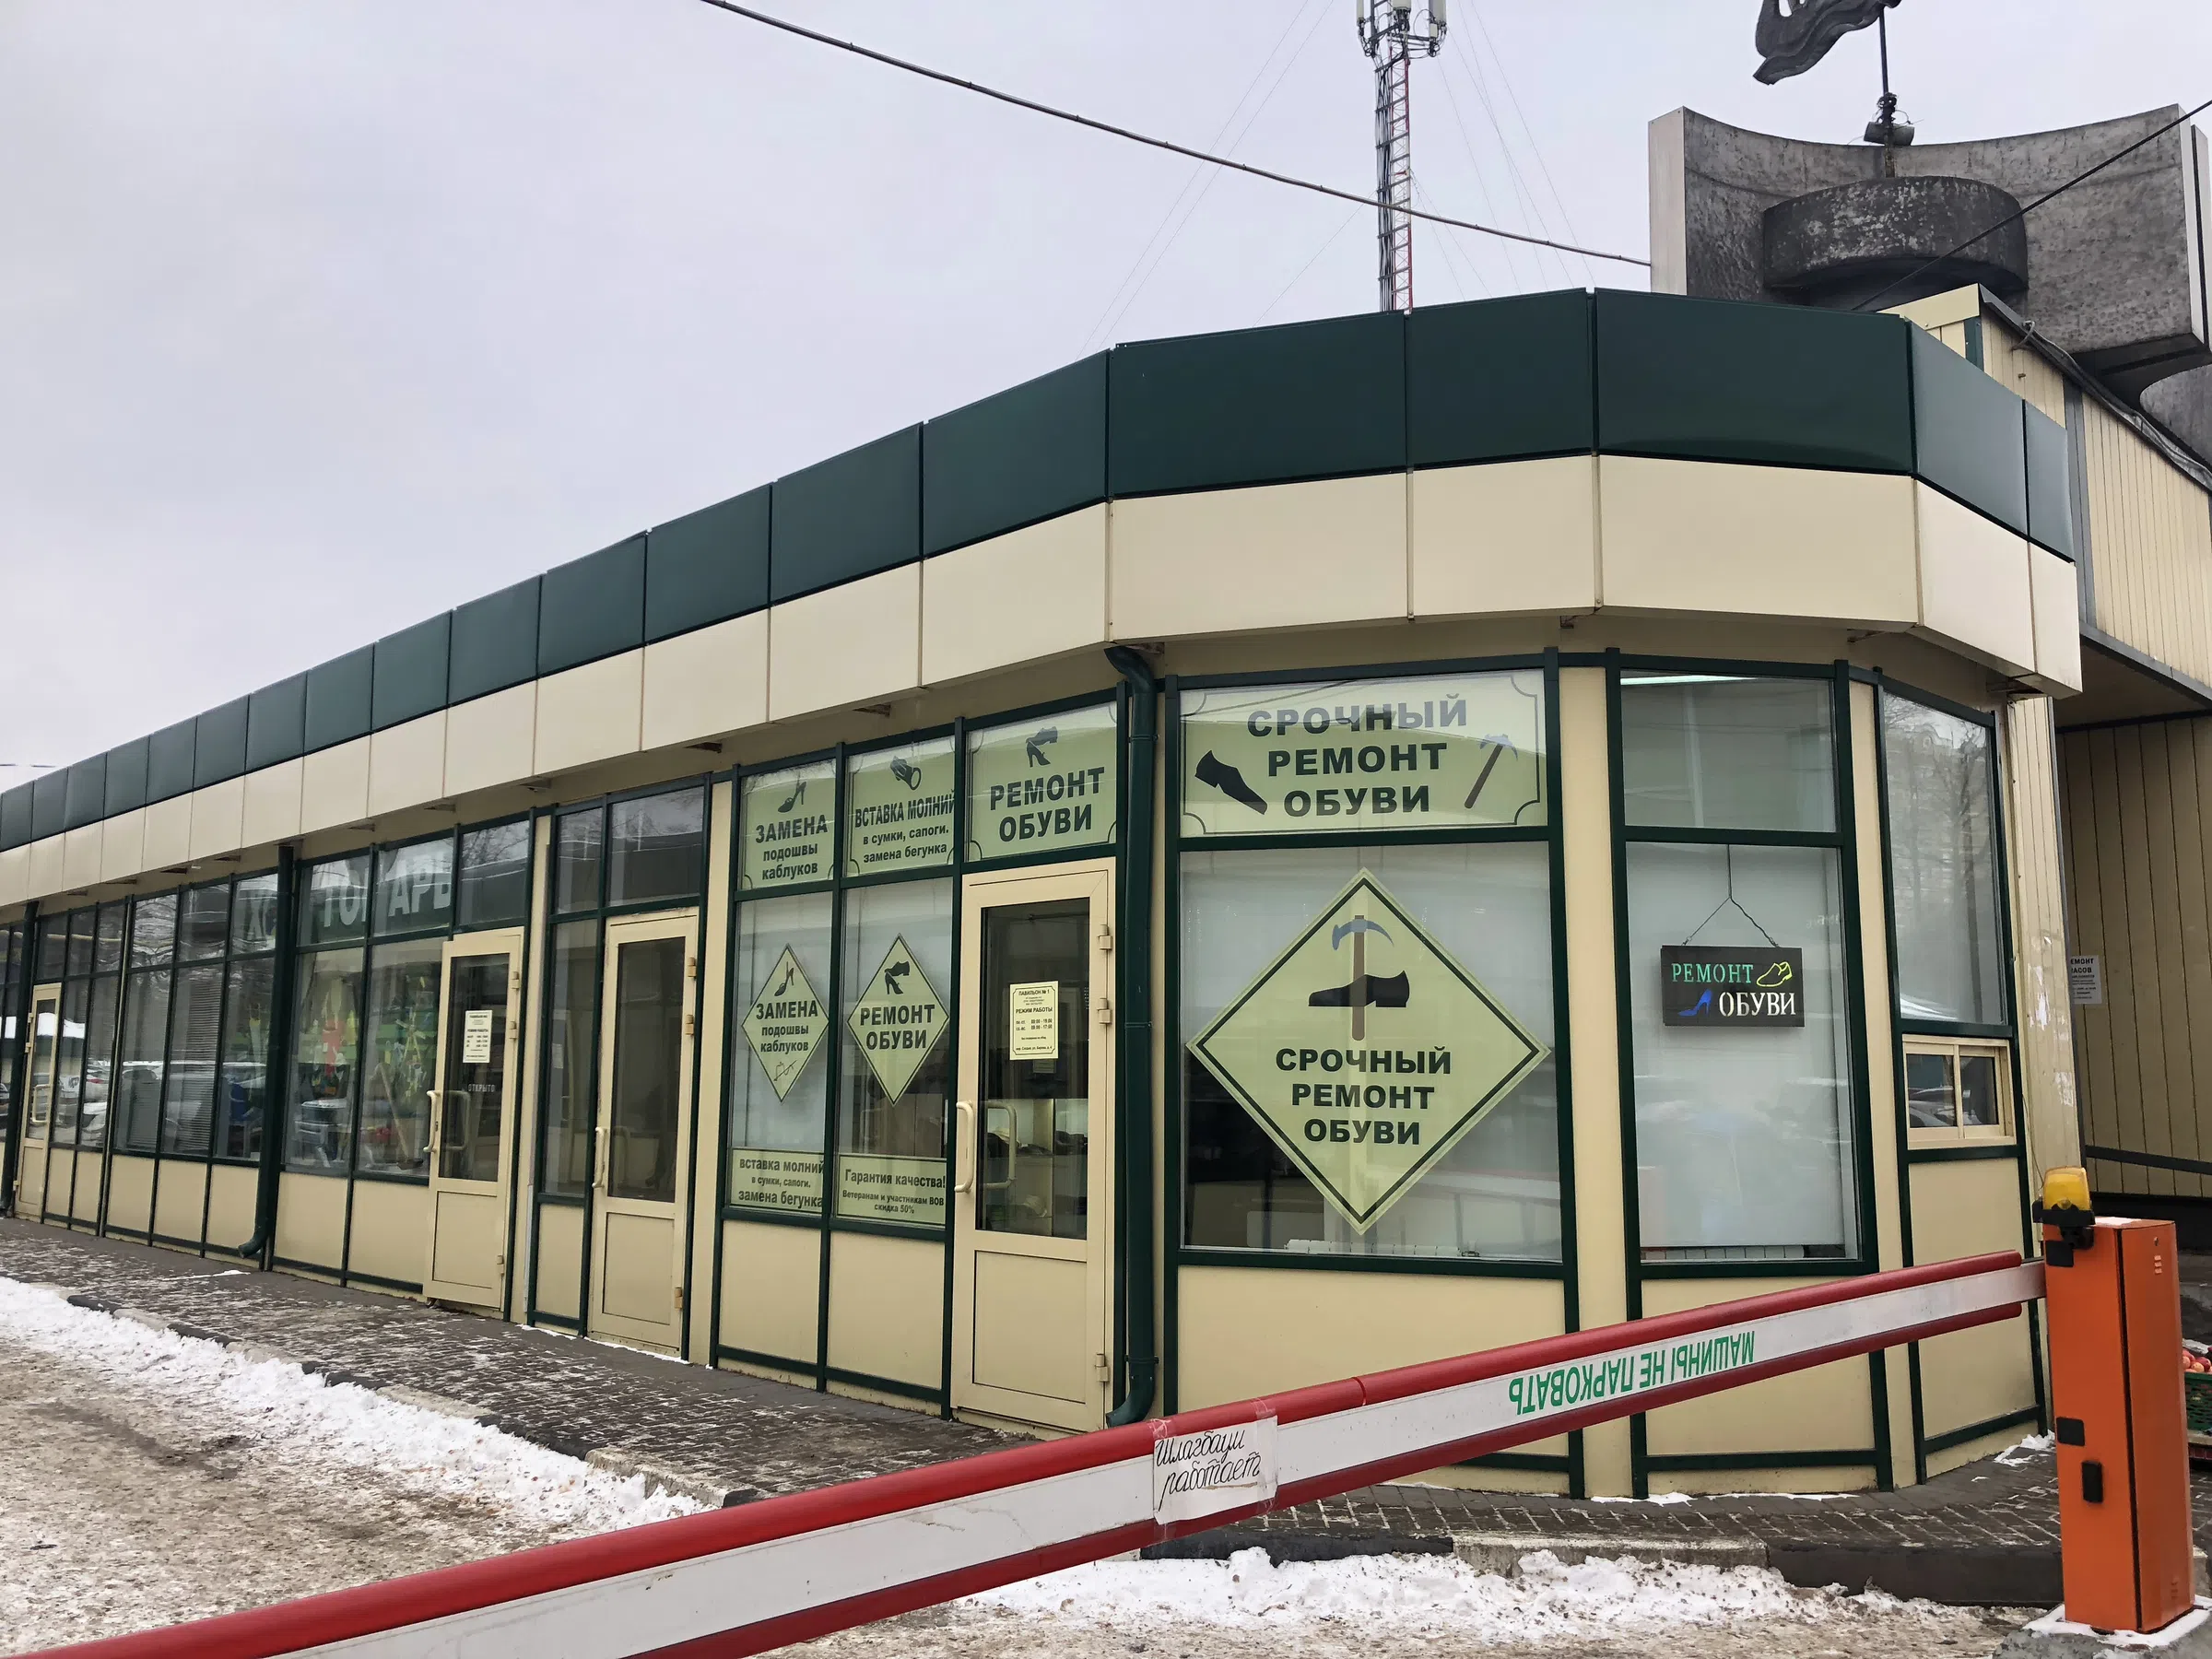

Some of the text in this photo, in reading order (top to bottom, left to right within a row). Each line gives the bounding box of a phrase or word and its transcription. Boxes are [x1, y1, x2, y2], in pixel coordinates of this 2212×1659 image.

[1248, 693, 1467, 737] СРОЧНЫЙ
[1268, 742, 1448, 777] РЕМОНТ
[990, 766, 1105, 811] РЕМОНТ
[1283, 785, 1430, 818] ОБУВИ
[854, 802, 904, 828] ВСТАВКА
[999, 804, 1093, 842] ОБУВИ
[755, 814, 828, 843] ЗАМЕНА
[863, 825, 949, 846] в сумки, сапоги.
[763, 842, 818, 861] подошвы
[864, 843, 947, 863] замена бегунка
[761, 861, 818, 881] каблуков
[1671, 962, 1754, 983] РЕМОНТ
[756, 1000, 818, 1020] ЗАМЕНА
[1719, 991, 1796, 1017] ОБУВИ
[860, 1004, 935, 1026] РЕМОНТ
[761, 1025, 809, 1037] подошвы
[865, 1030, 927, 1051] ОБУВИ
[760, 1041, 808, 1054] каблуков
[1276, 1045, 1452, 1075] СРОЧНЫЙ
[468, 1083, 496, 1092] ОТКРЫТО
[1291, 1083, 1435, 1110] РЕМОНТ
[1304, 1119, 1421, 1146] ОБУВИ
[739, 1159, 780, 1171] вставка
[757, 1176, 782, 1187] сумки,
[783, 1178, 811, 1188] сапоги.
[845, 1169, 946, 1188] Гарантия качества!
[738, 1191, 777, 1203] замена
[842, 1189, 879, 1200] Ветеранам
[887, 1194, 927, 1205] участникам
[929, 1196, 945, 1206] ВОВ
[874, 1203, 914, 1214] скидка 50%
[1509, 1330, 1755, 1415] МАШИНЫ НЕ ПАРКОВАТЬ
[1158, 1451, 1262, 1512] работает
